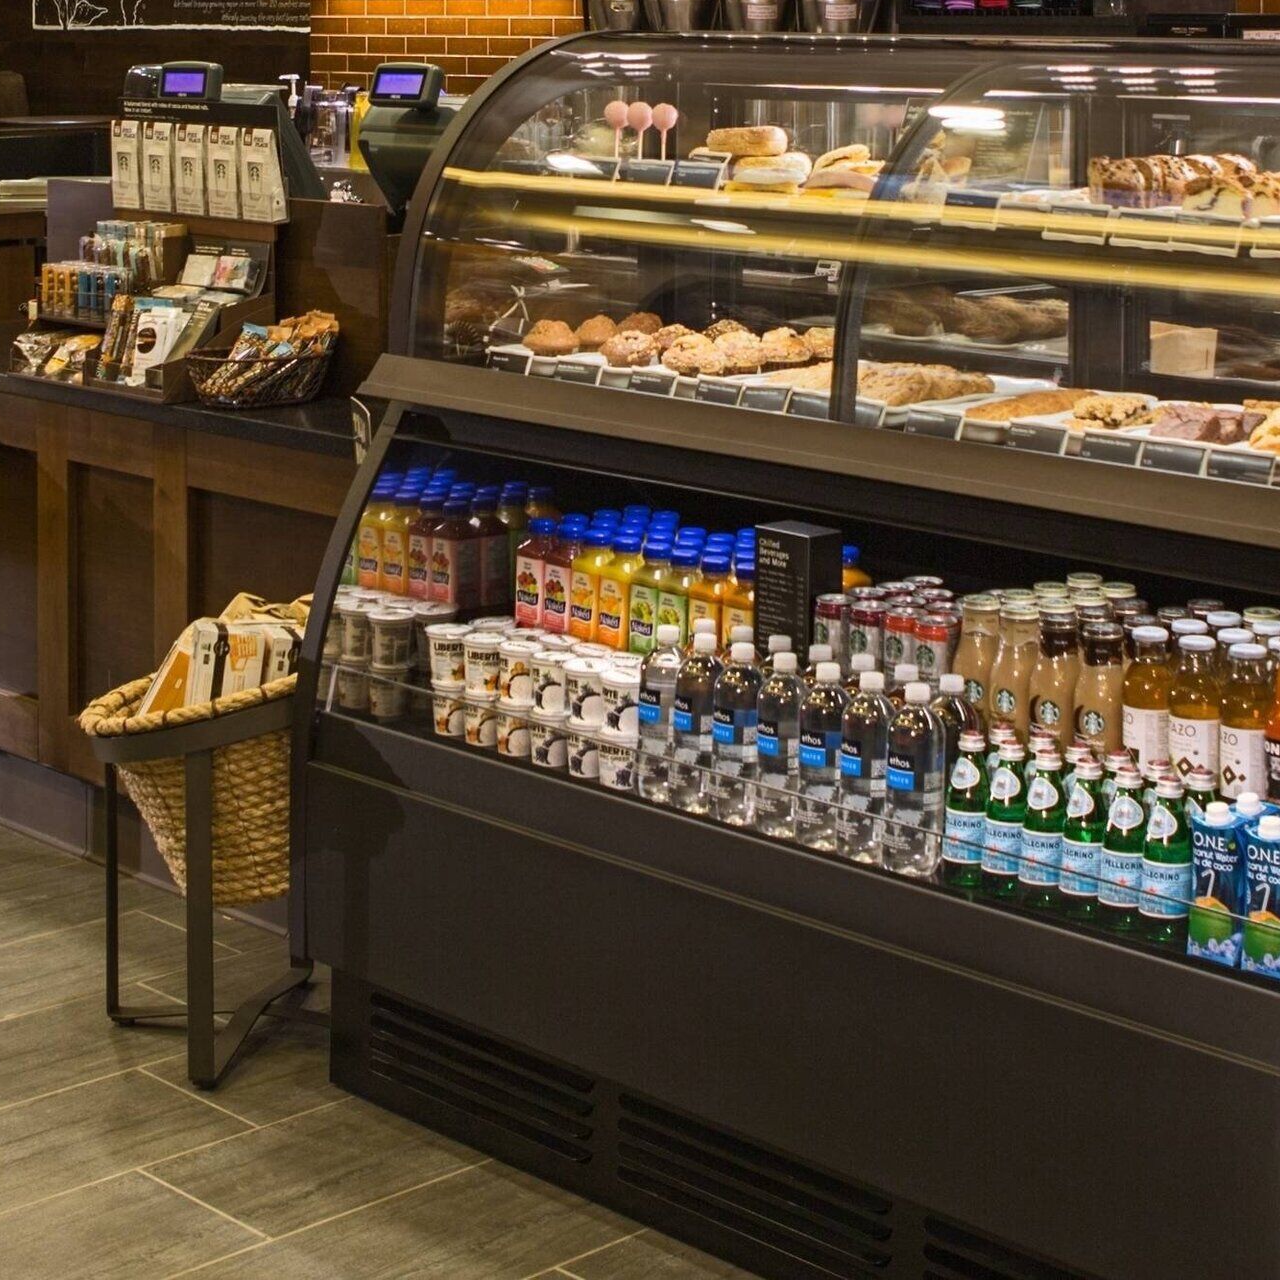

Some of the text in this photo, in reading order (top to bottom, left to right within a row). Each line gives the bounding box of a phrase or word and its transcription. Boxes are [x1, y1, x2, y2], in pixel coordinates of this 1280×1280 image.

[433, 642, 464, 652] LIBERT
[1171, 724, 1195, 737] AZO
[802, 734, 821, 745] ethos
[890, 757, 909, 768] ethos
[1194, 831, 1227, 852] O.N.E.
